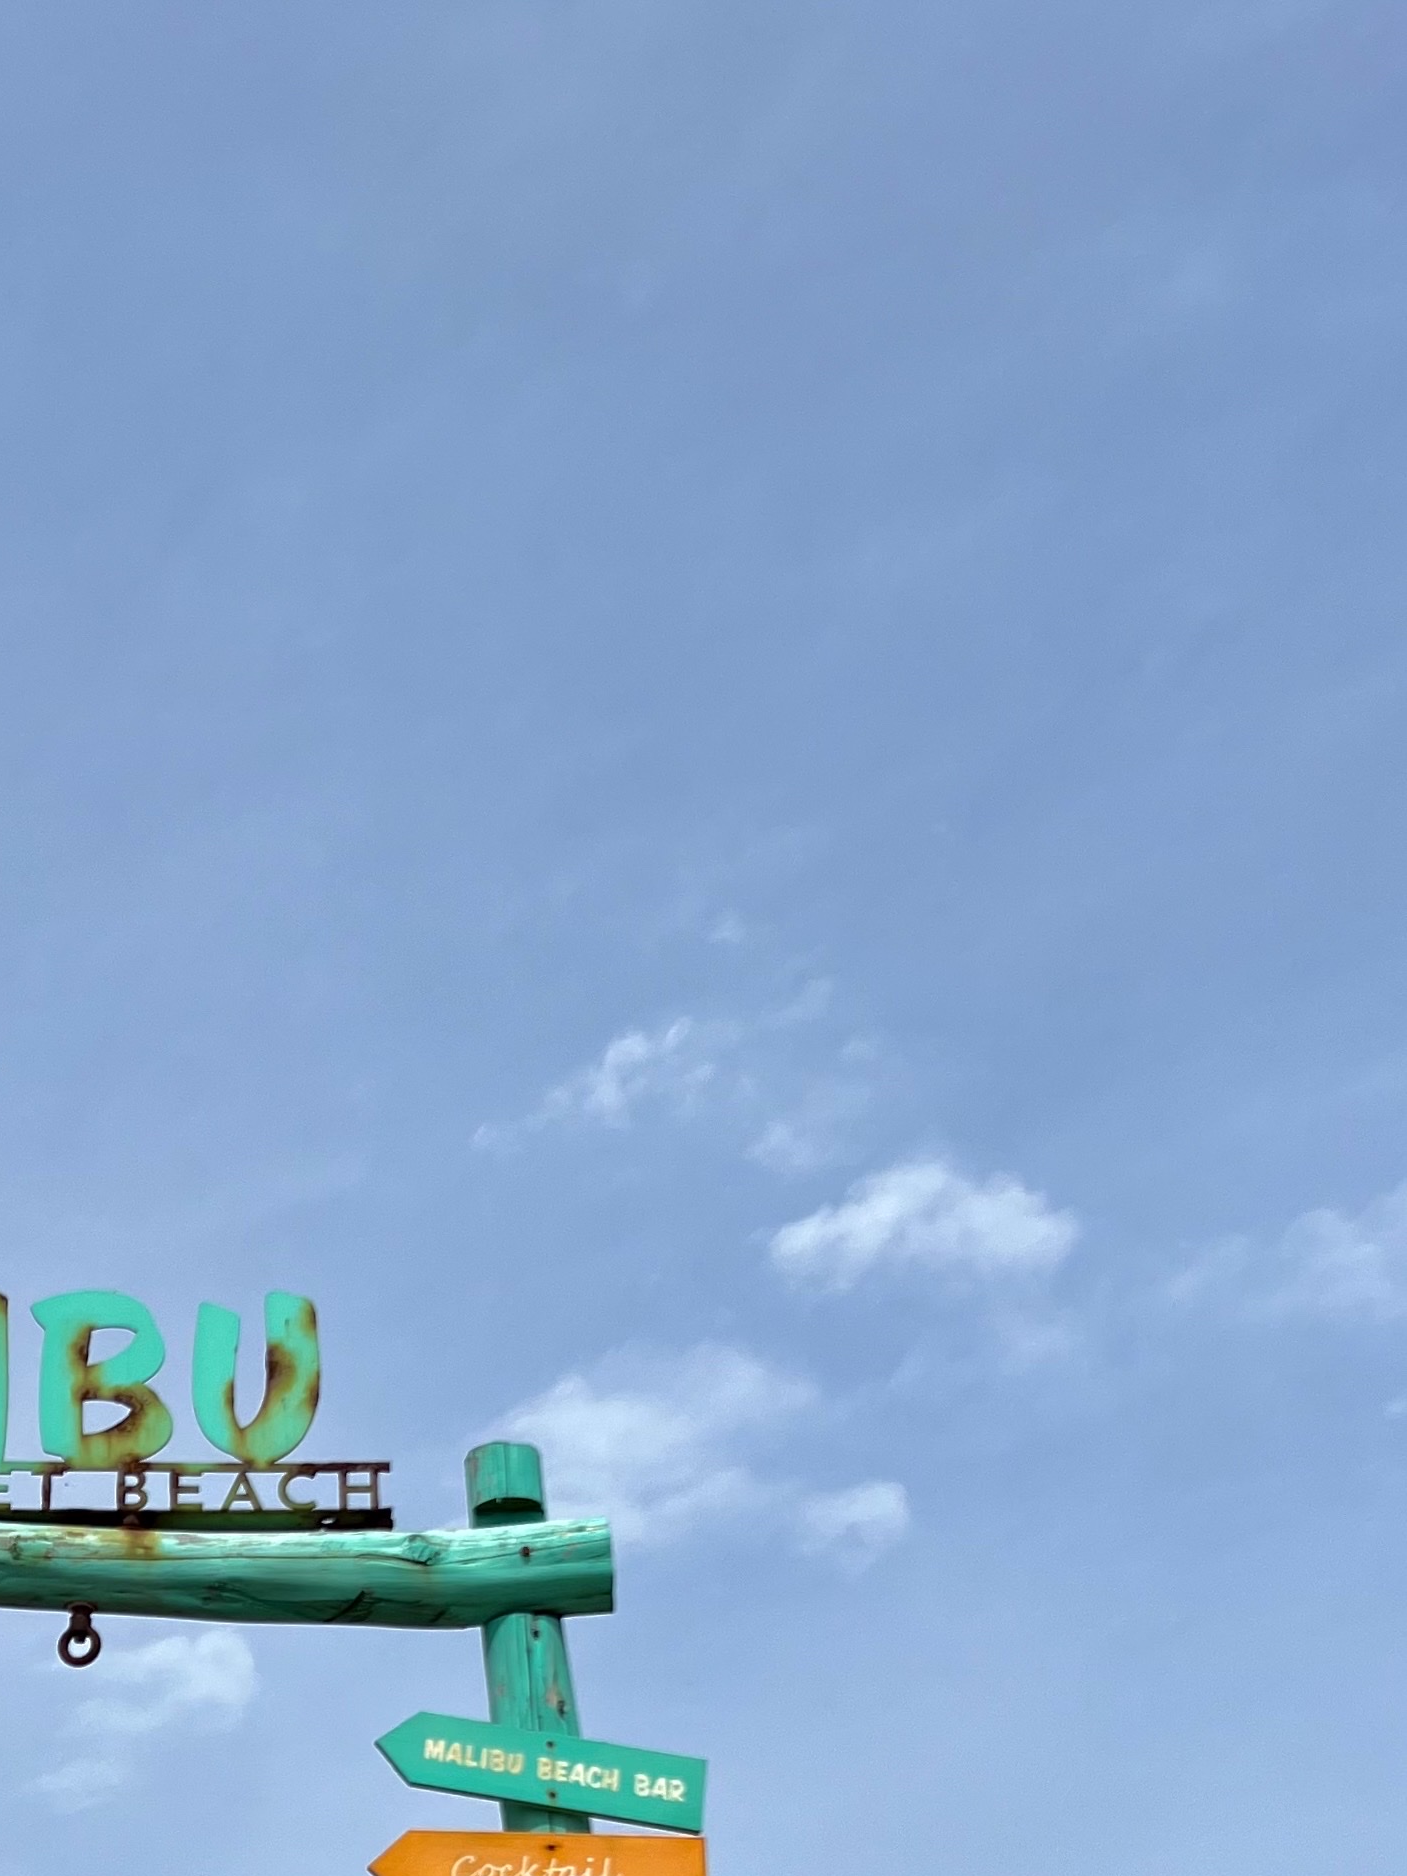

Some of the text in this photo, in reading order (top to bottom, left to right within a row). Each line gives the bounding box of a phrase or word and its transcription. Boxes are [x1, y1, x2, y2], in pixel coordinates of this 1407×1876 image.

[116, 1464, 380, 1514] BEACH
[423, 1739, 687, 1802] MALIBU BEACH BAR
